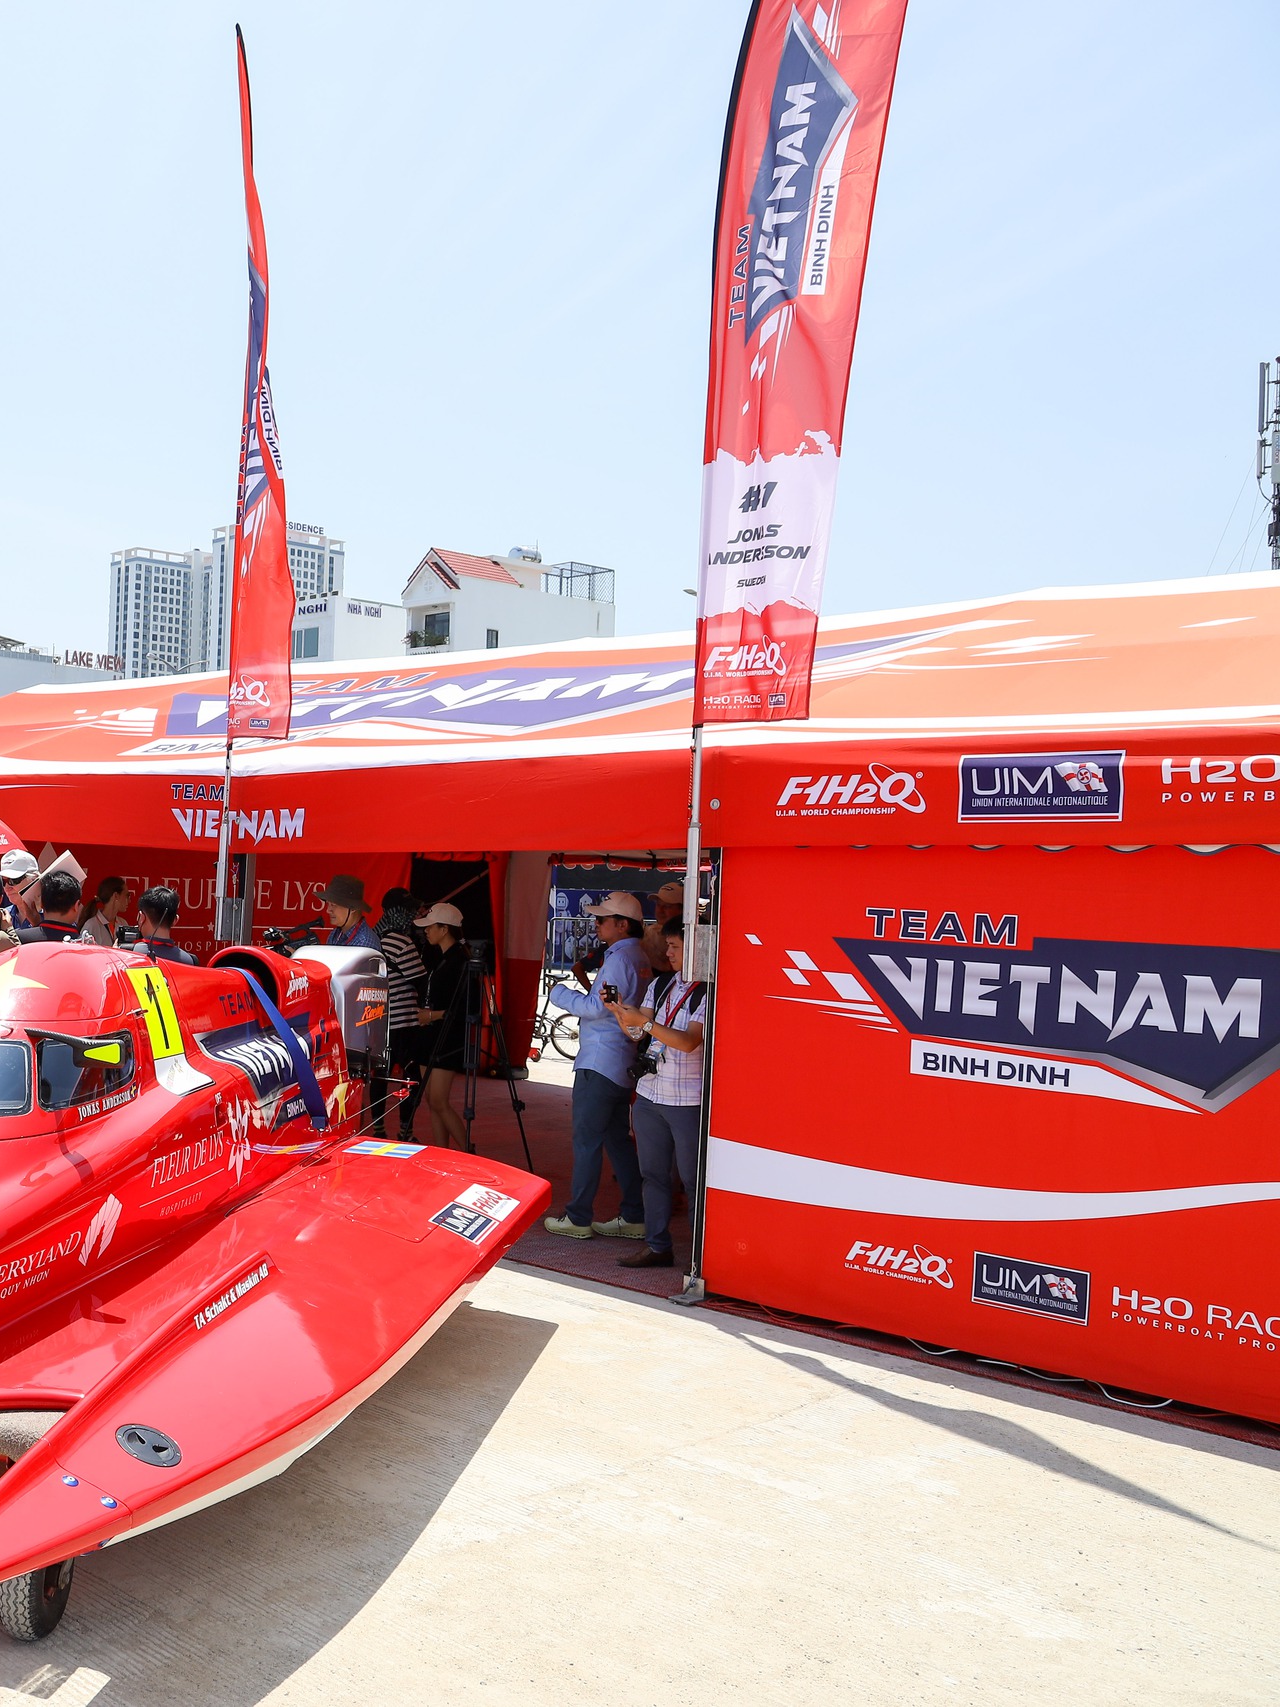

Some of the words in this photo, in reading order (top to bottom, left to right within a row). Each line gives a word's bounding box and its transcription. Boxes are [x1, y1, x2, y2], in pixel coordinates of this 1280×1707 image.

[751, 81, 818, 319] VIETNAM
[816, 185, 835, 234] DINH
[728, 223, 751, 329] TEAM
[810, 239, 827, 287] BINH
[738, 481, 778, 513] #1
[65, 649, 93, 669] LAKE
[97, 653, 125, 672] VIEW
[971, 766, 1053, 796] UIM
[1161, 754, 1280, 785] H2O
[171, 784, 224, 801] TEAM
[776, 762, 926, 814] F1H2O
[971, 797, 993, 807] UNION
[994, 796, 1051, 807] INTERNATIONALE
[1052, 795, 1108, 807] MOTONAUTIQUE
[1161, 790, 1275, 804] POWERB
[171, 808, 305, 846] VIETNAM
[831, 807, 896, 816] CHAMPIONSHIP
[866, 906, 1019, 947] TEAM
[867, 953, 1262, 1043] VIETNAM
[921, 1051, 991, 1079] BINH
[996, 1059, 1071, 1087] DINH
[78, 1102, 100, 1121] JONAS
[102, 1089, 131, 1111] ANDERSSON
[150, 1146, 190, 1189] FLEUR
[193, 1137, 208, 1170] DE
[209, 1130, 225, 1164] LYS
[160, 1191, 202, 1217] HOSPITALITY
[844, 1262, 861, 1271] U.I.M.
[863, 1266, 884, 1275] WORLD
[885, 1270, 933, 1285] CHAMPIONSHP
[845, 1240, 954, 1289] F1H2O
[982, 1264, 1040, 1295] UIM
[0, 1282, 21, 1299] QUY
[194, 1312, 206, 1330] TA
[205, 1294, 231, 1322] Schakt
[229, 1288, 237, 1303] &
[235, 1272, 260, 1298] Maskin
[259, 1263, 269, 1281] AB
[981, 1285, 997, 1296] UNION
[997, 1288, 1038, 1303] INTERNATIONALE
[1039, 1297, 1079, 1312] MOTONAUTIQUE
[1112, 1286, 1194, 1320] H2O
[1207, 1304, 1280, 1339] RAC
[1111, 1311, 1225, 1341] POWERBOAT
[1238, 1336, 1276, 1351] PRO
